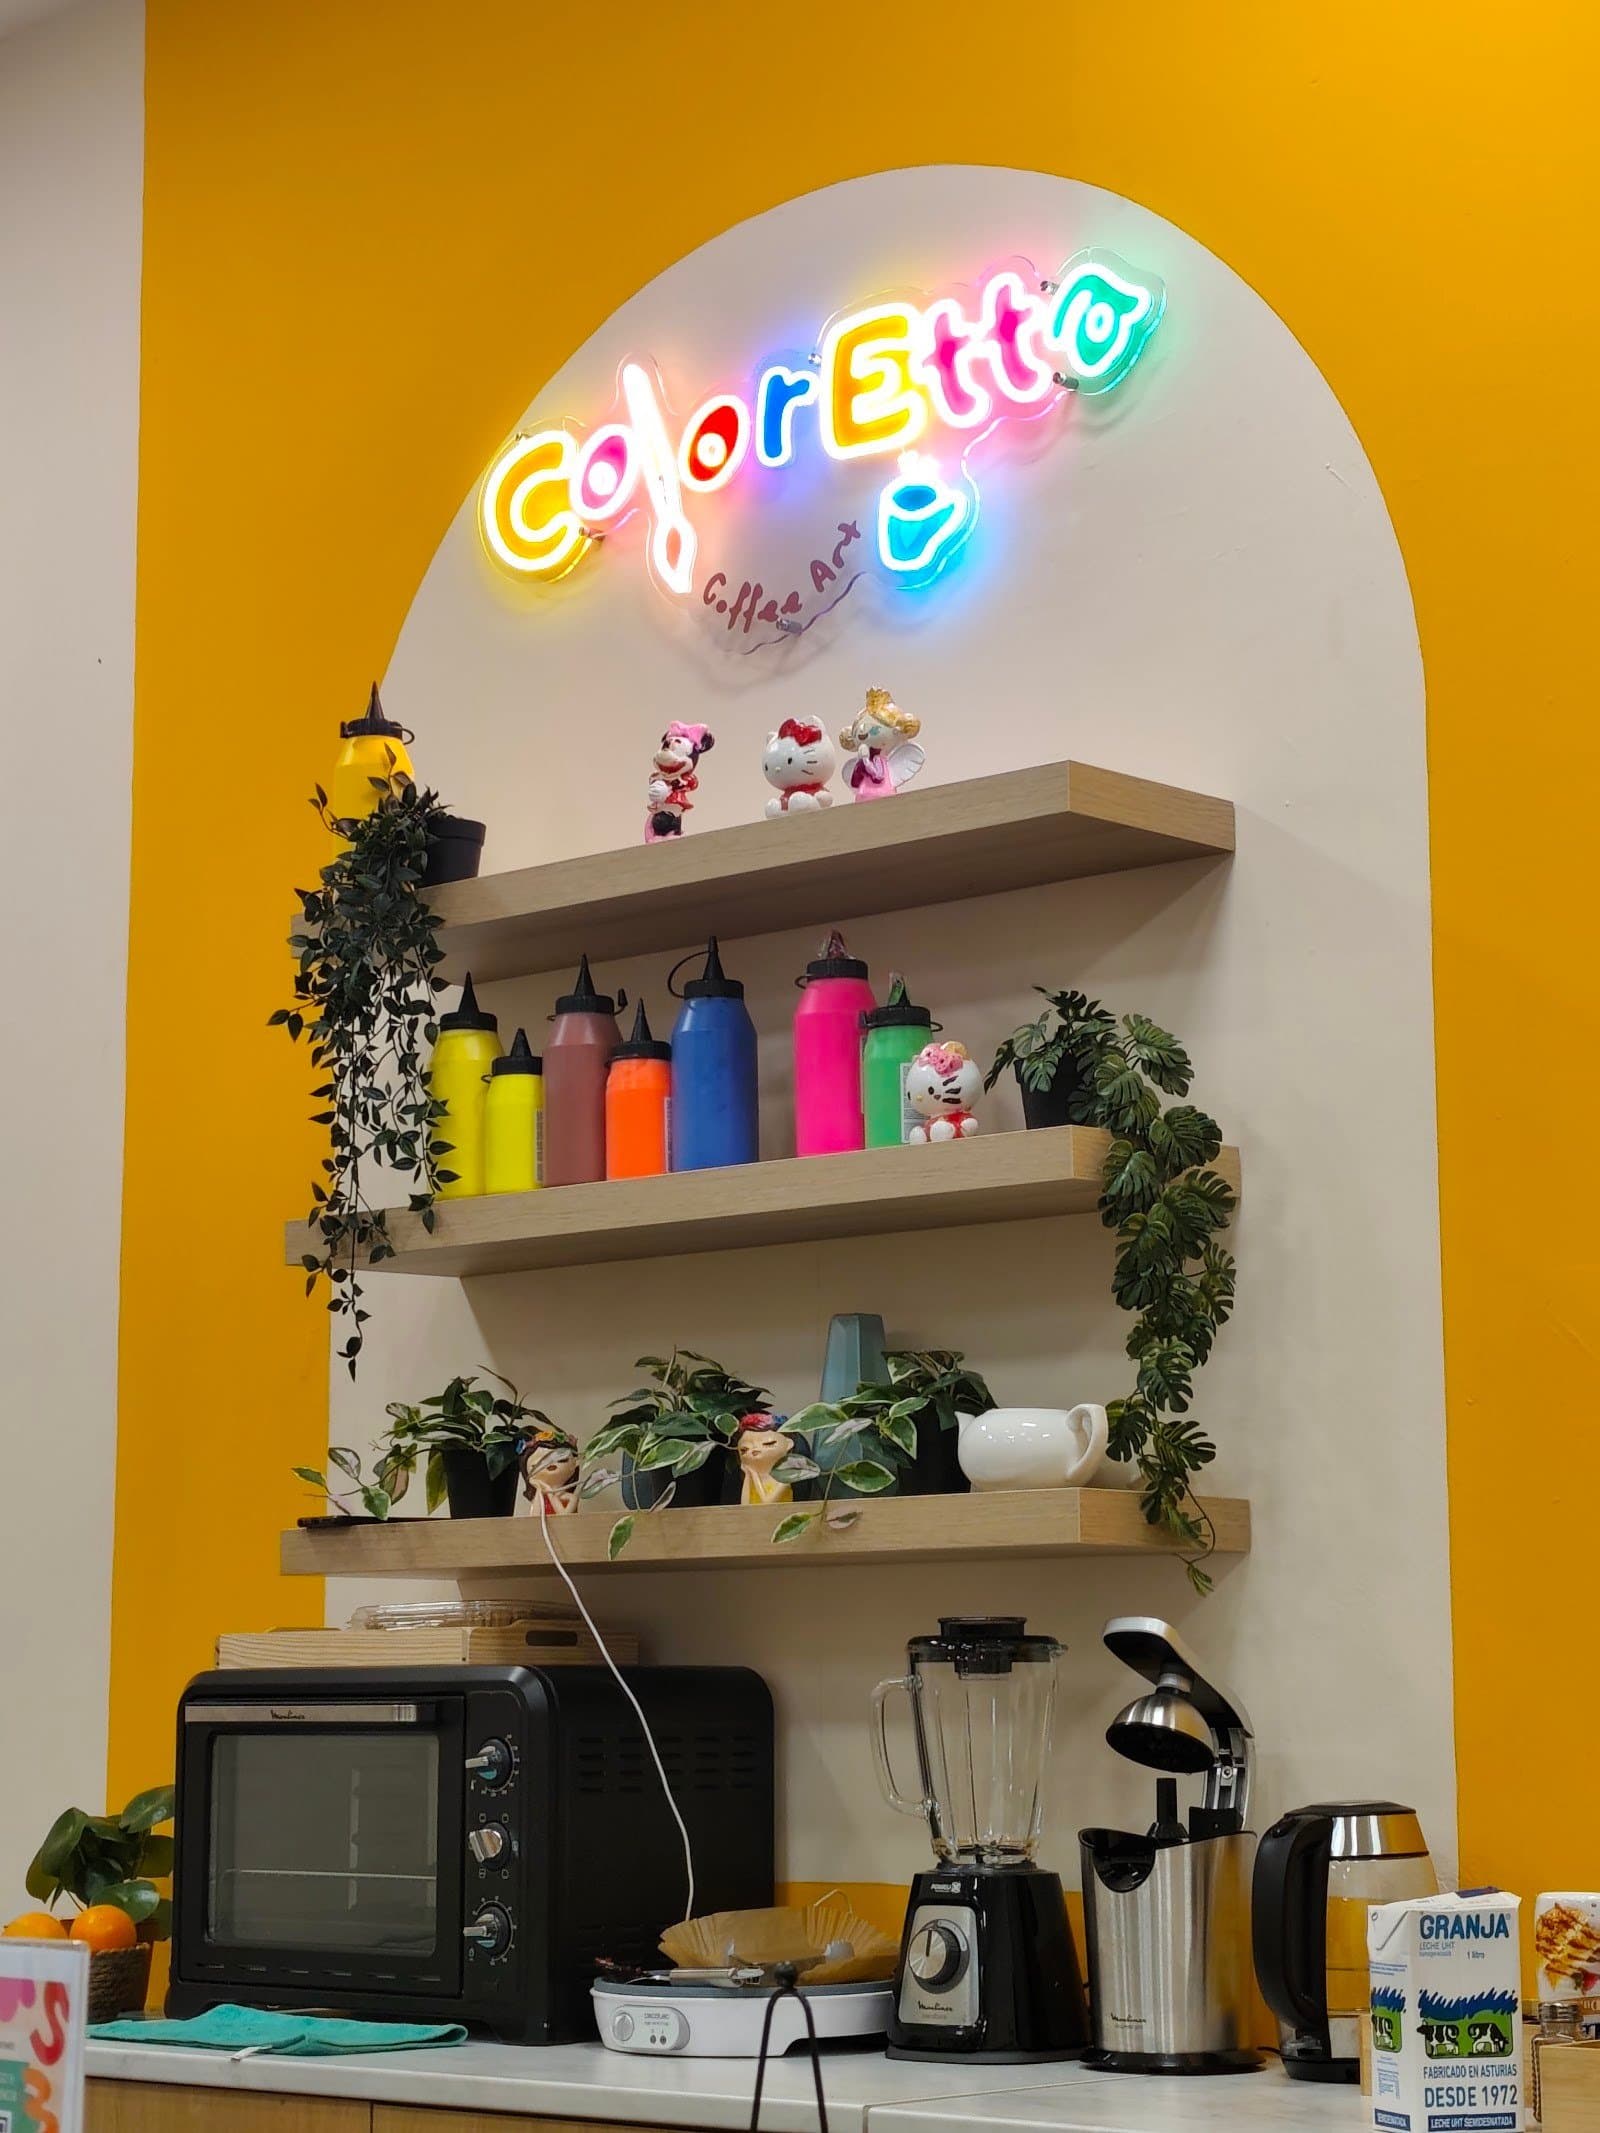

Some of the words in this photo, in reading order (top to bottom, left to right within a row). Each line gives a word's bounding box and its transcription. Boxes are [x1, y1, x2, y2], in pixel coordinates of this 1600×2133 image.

[703, 573, 802, 633] Coffee
[810, 520, 861, 592] Art
[1420, 1913, 1509, 1939] GRANJA
[1419, 1941, 1440, 1950] LECHE
[1423, 2065, 1466, 2079] FABRICADO
[1468, 2064, 1479, 2078] EN
[1481, 2063, 1517, 2077] ASTURIAS
[1424, 2086, 1477, 2108] DESDE
[1481, 2084, 1518, 2107] 1972
[1431, 2118, 1450, 2128] LECHE
